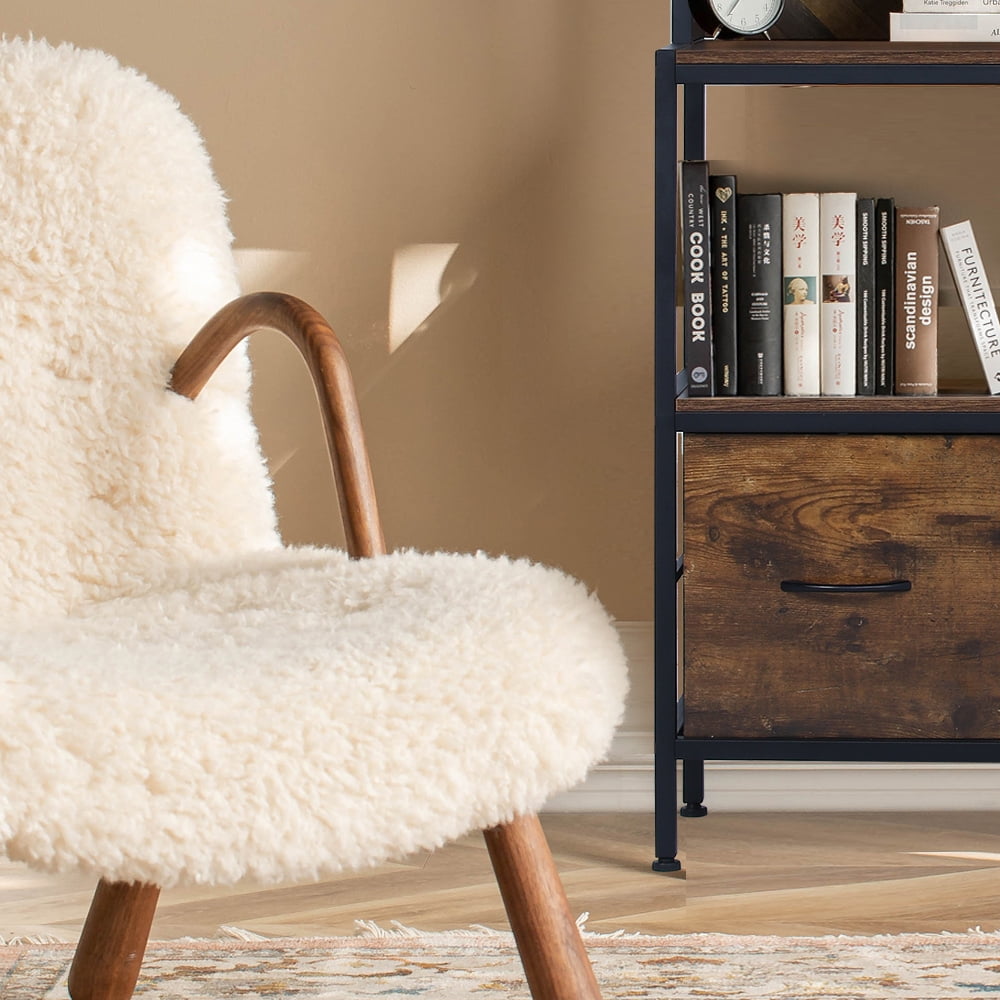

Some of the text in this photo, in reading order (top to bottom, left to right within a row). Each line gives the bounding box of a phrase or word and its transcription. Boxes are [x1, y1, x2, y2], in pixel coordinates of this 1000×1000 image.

[720, 234, 728, 249] THE
[792, 216, 807, 249] 美学
[831, 214, 846, 247] 美学
[689, 231, 706, 343] COOK BOOK
[721, 284, 729, 313] TATTOO
[904, 251, 917, 350] scandinavian
[919, 275, 935, 326] design
